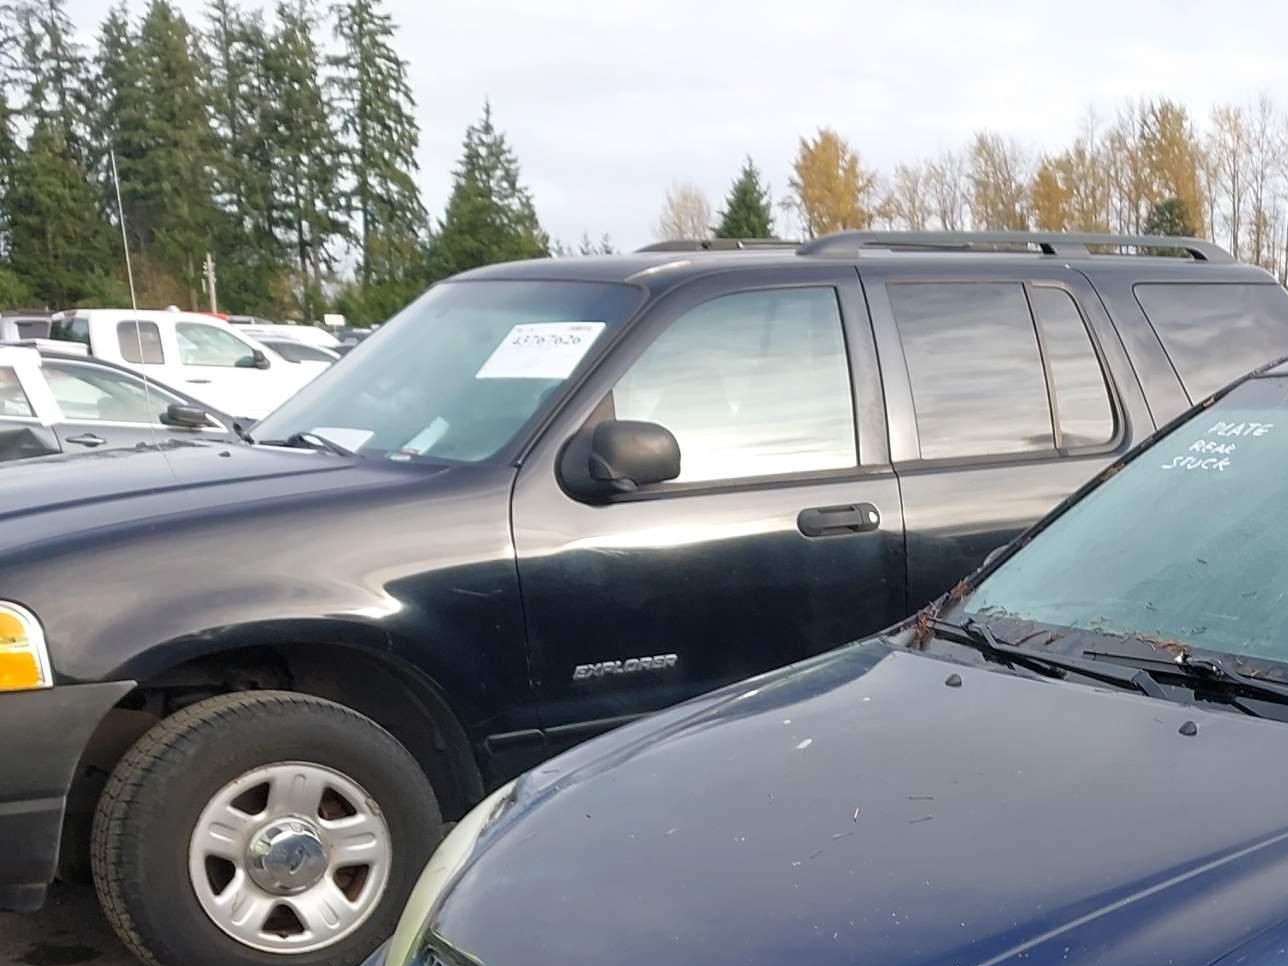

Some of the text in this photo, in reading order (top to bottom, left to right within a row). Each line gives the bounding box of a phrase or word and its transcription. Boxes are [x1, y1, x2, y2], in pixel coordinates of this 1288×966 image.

[1208, 421, 1274, 436] PLATE
[1188, 439, 1236, 454] REAR
[1160, 456, 1231, 471] STUCK
[573, 653, 678, 681] EXPLORER
